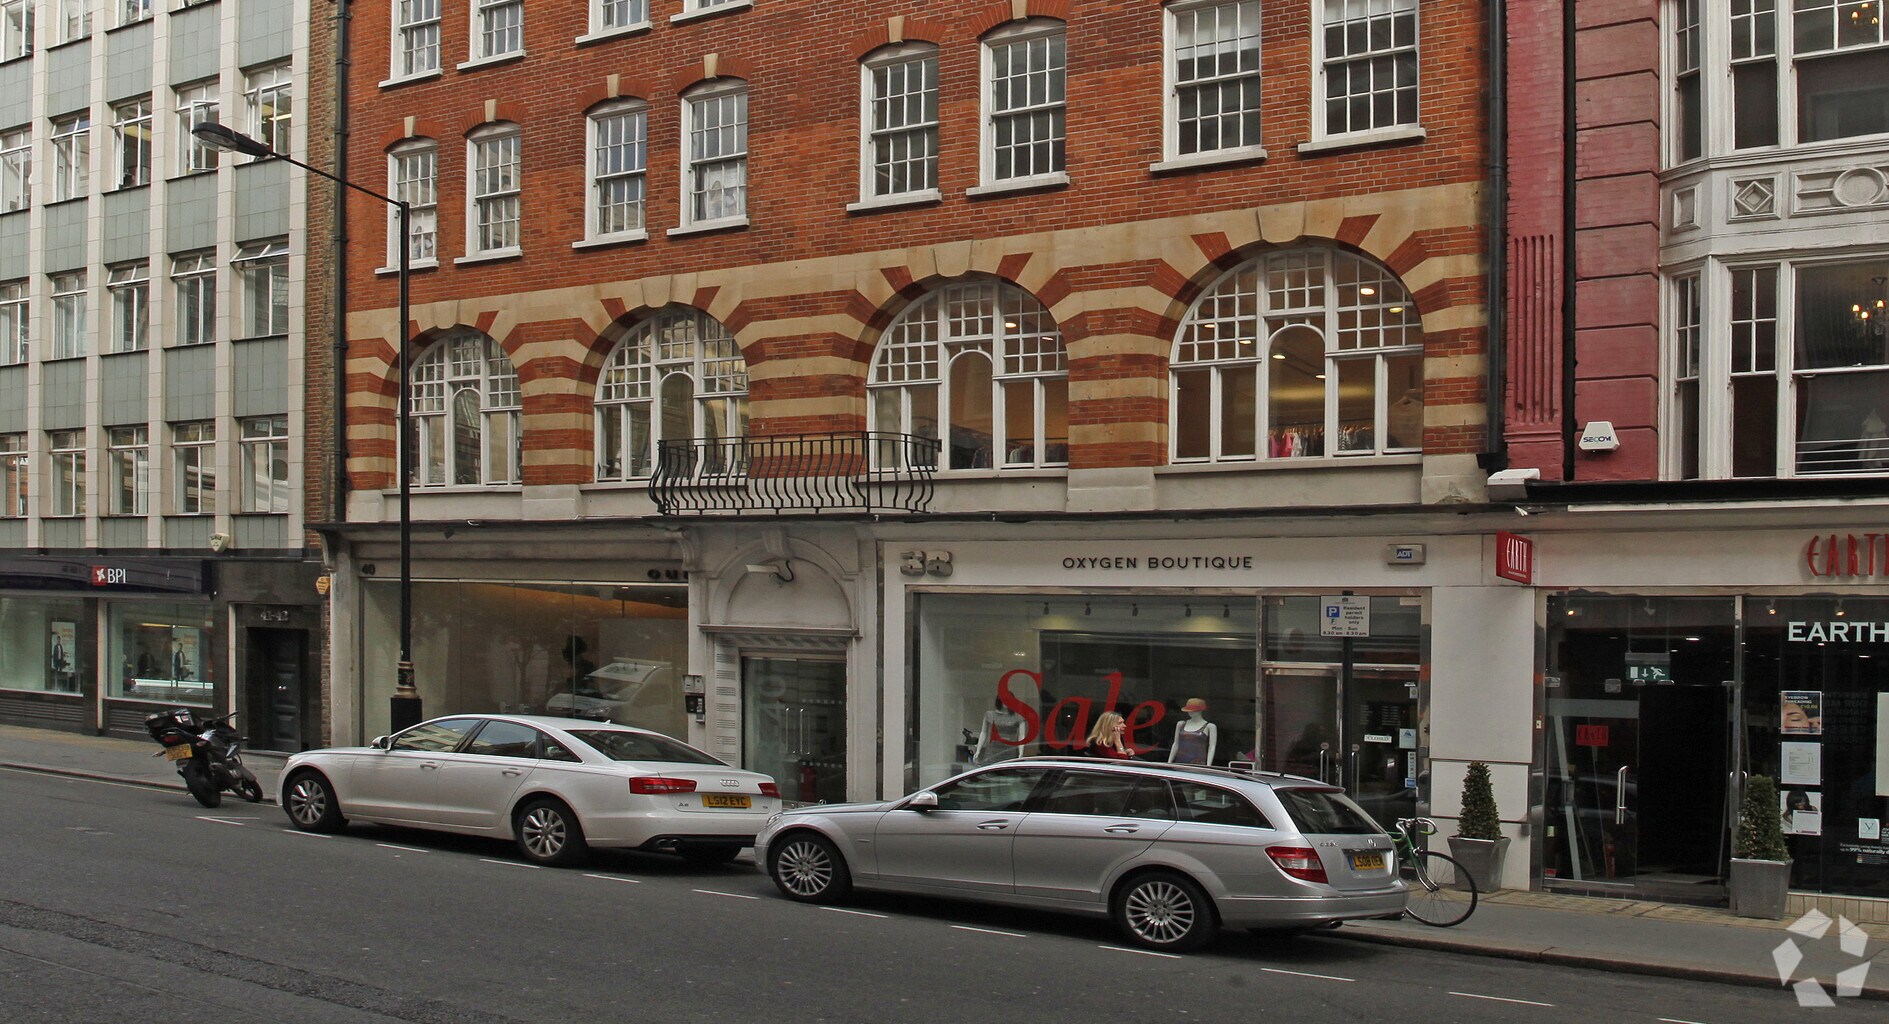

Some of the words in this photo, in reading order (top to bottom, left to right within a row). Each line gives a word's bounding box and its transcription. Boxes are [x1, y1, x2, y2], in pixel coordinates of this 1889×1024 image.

[1583, 435, 1611, 443] SECOM
[1396, 550, 1412, 558] ADT
[1506, 538, 1528, 573] EARTH
[900, 550, 953, 576] 38
[1062, 557, 1138, 569] OXYGEN
[1148, 556, 1252, 570] BOUTIQUE
[107, 568, 127, 584] BPI
[1787, 621, 1889, 643] EARTH
[990, 668, 1167, 755] Sale
[708, 797, 728, 805] LS12
[730, 797, 747, 806] EYC
